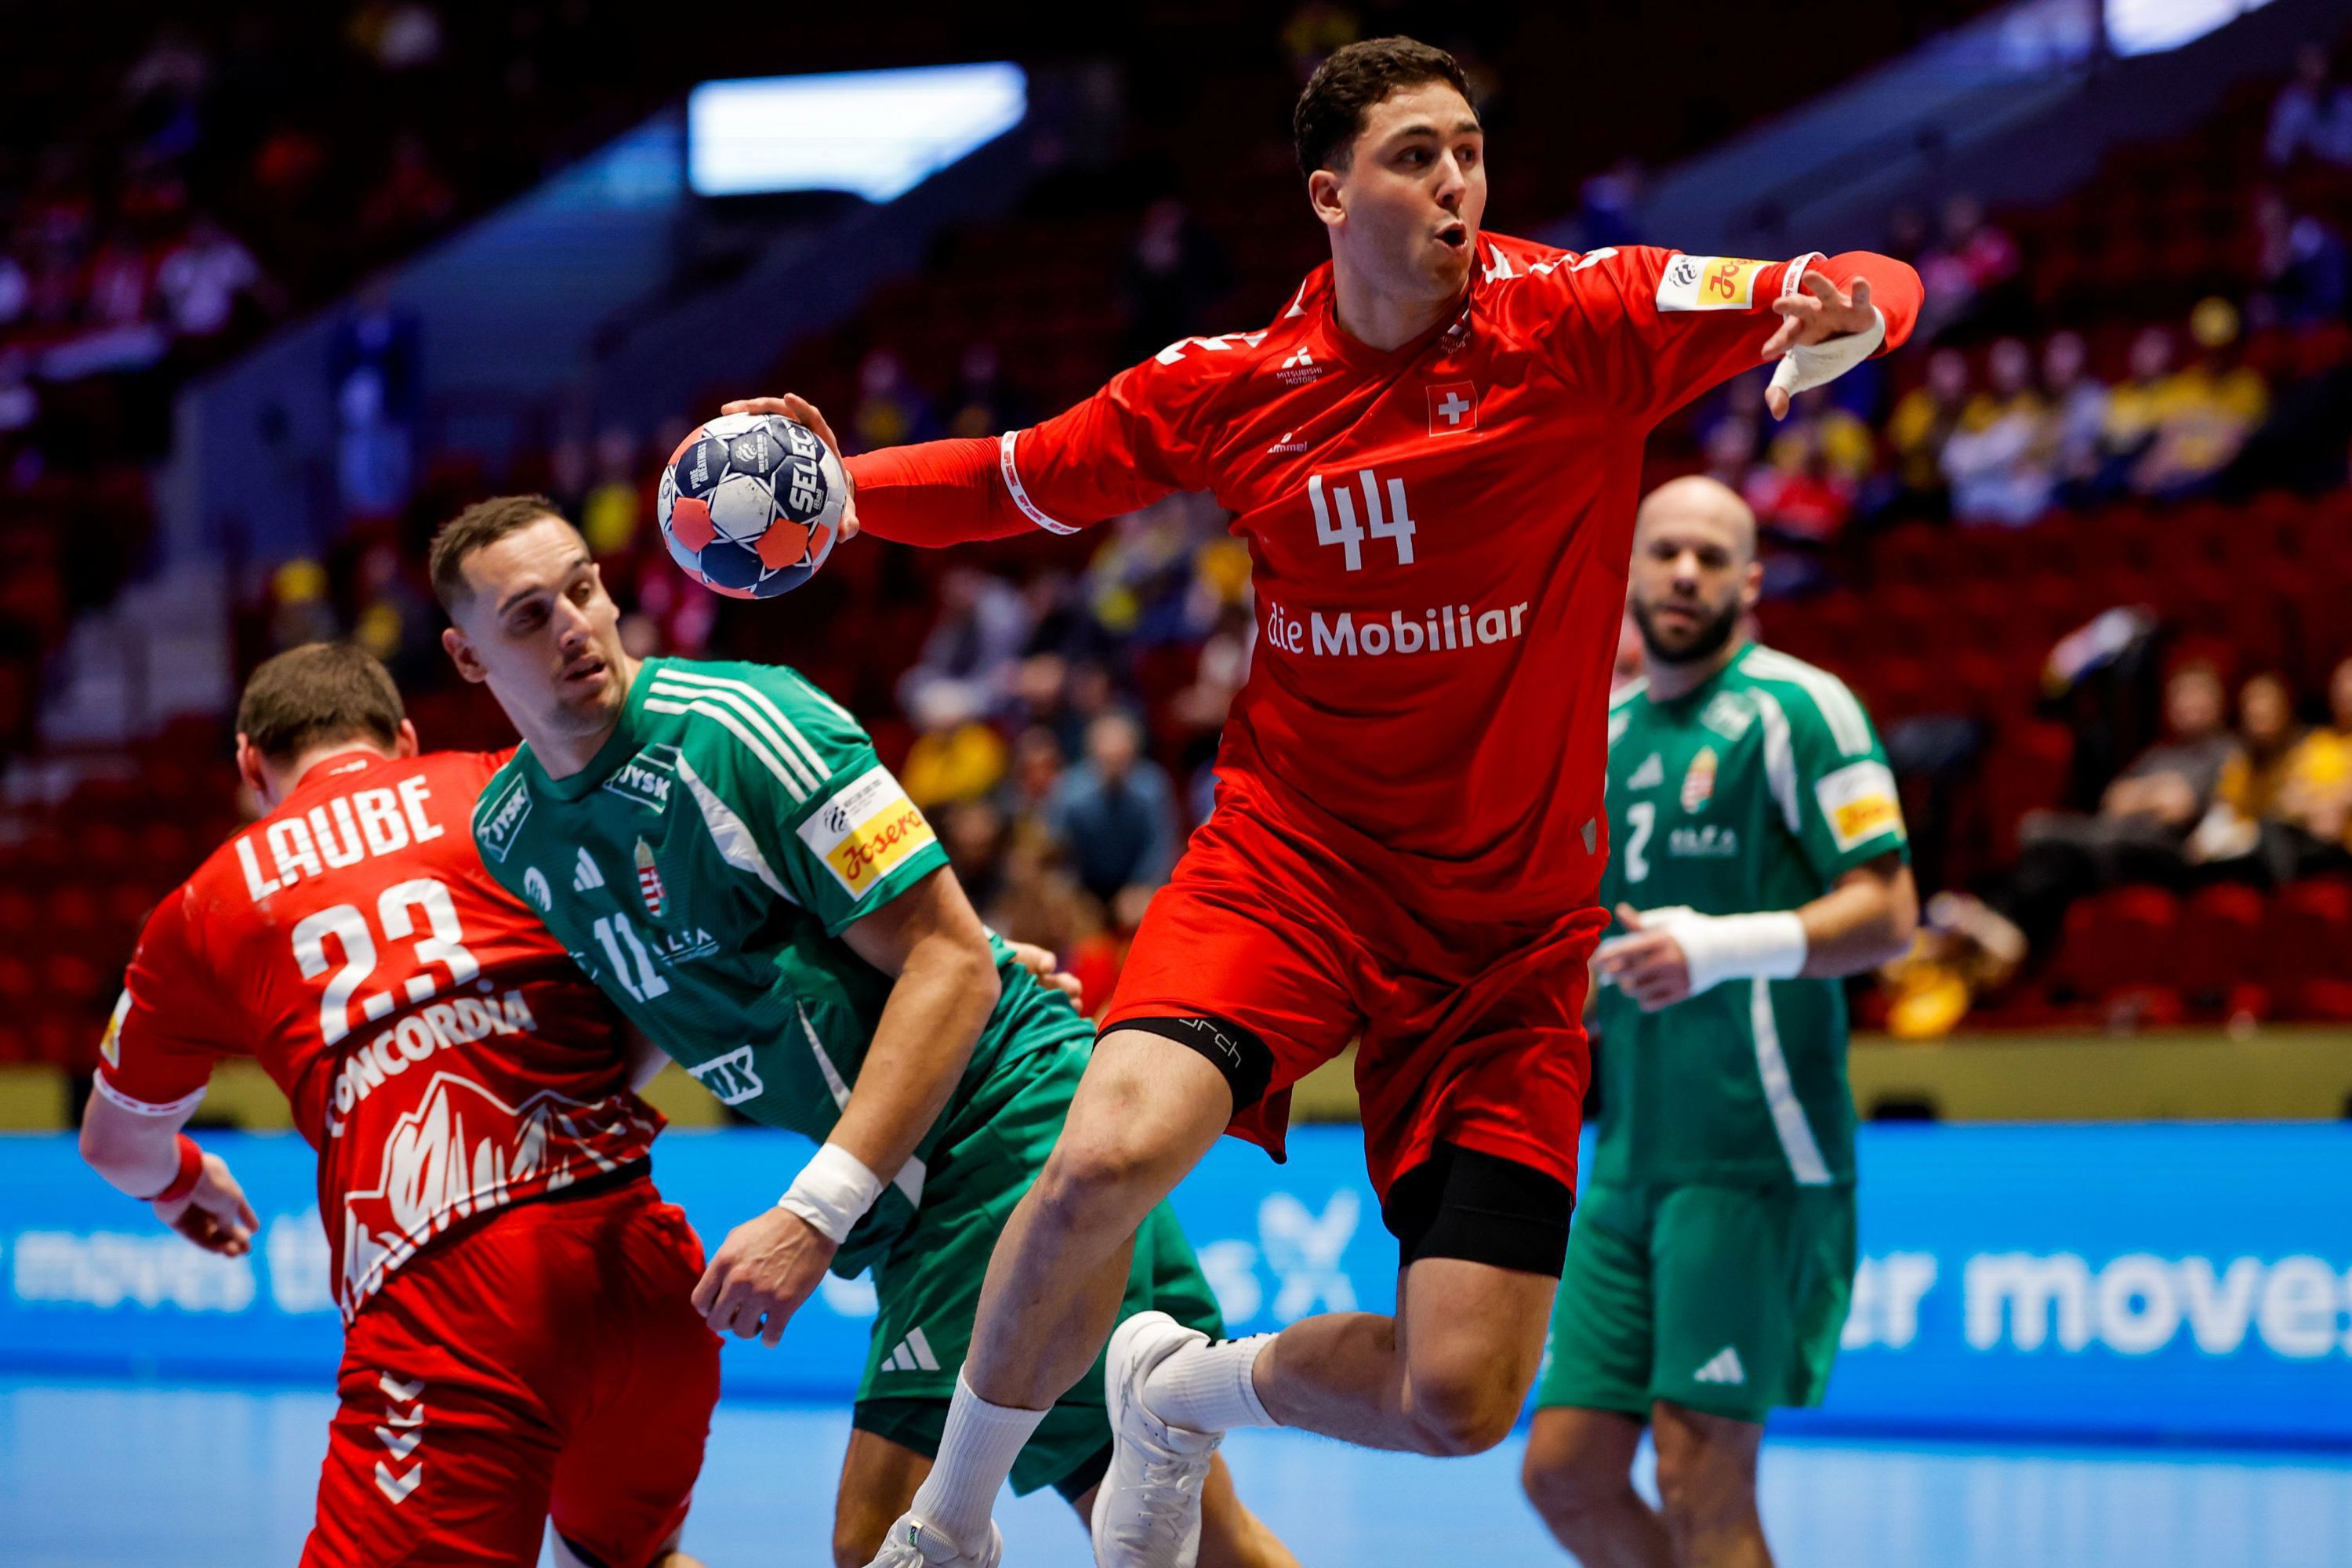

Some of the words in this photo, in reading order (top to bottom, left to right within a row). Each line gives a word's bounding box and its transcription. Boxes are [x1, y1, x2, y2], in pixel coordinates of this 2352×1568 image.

[1276, 366, 1323, 379] MITSUBISHI
[1286, 375, 1317, 385] MOTORS
[697, 443, 709, 482] GREATNESS
[1267, 441, 1308, 453] ummel
[690, 468, 701, 489] PURE
[1308, 470, 1416, 572] 44
[1268, 602, 1304, 655] die
[1311, 601, 1528, 656] Mobiliar
[619, 764, 671, 801] JYSK
[236, 775, 444, 902] LAUBE
[490, 786, 527, 841] JYSK
[843, 809, 922, 880] Josera
[292, 878, 480, 1047] 23
[593, 912, 670, 1003] 11
